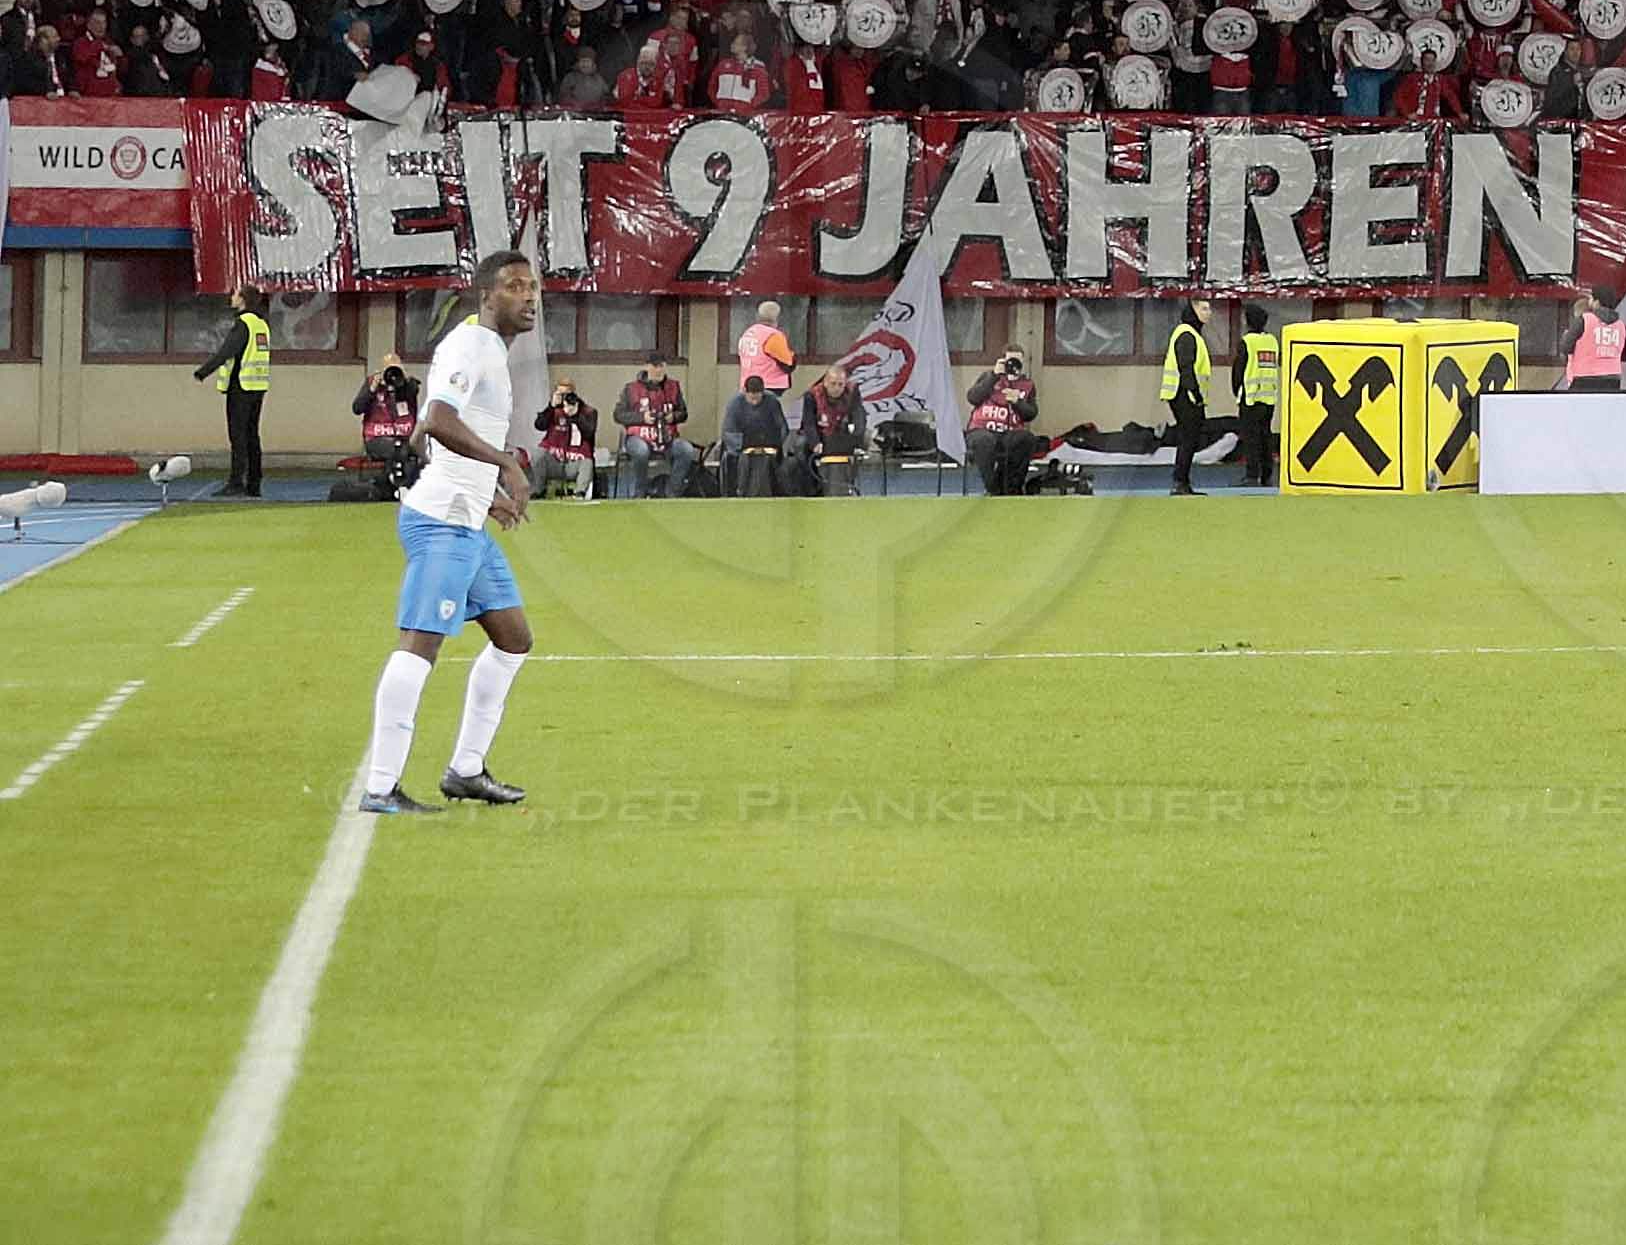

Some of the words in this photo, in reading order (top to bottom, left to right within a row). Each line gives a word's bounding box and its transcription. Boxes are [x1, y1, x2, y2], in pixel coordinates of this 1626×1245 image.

[39, 145, 103, 170] WILD
[246, 110, 627, 278] SEIT
[663, 118, 774, 280] 9
[815, 122, 1580, 282] JAHREN
[1593, 326, 1620, 347] 154
